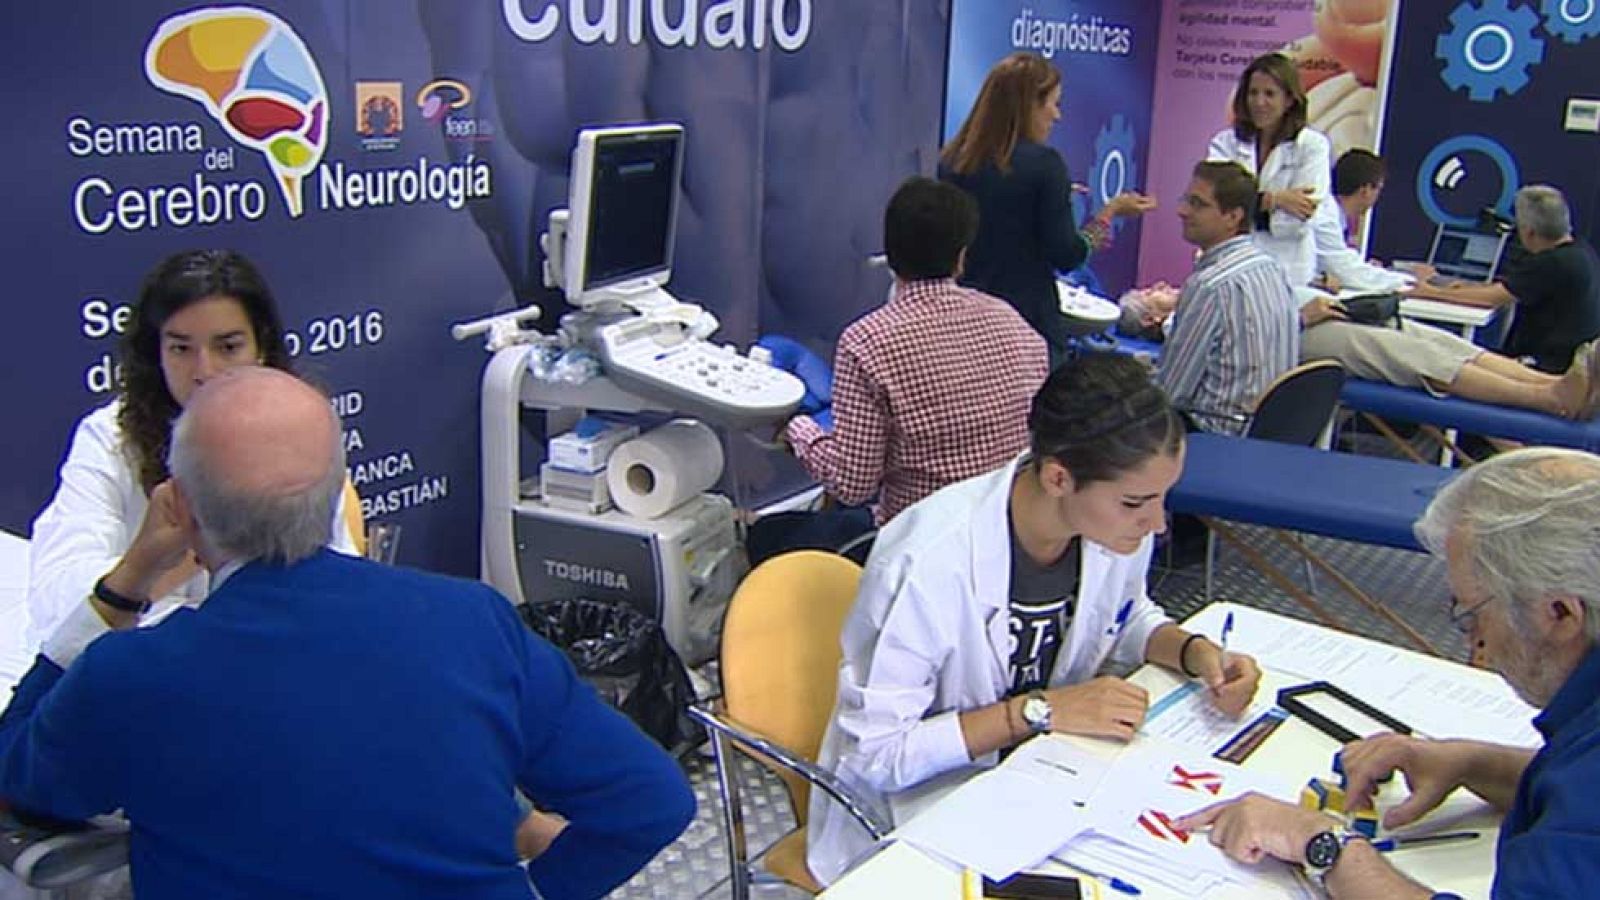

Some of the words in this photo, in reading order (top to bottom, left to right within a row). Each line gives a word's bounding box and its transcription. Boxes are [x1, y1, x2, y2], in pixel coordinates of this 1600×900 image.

[1013, 8, 1131, 58] diagnósticas
[1176, 49, 1217, 65] Tarjeta
[68, 118, 201, 155] Semana
[205, 147, 234, 170] del
[320, 155, 490, 209] Neurología
[74, 174, 266, 233] Cerebro
[309, 311, 383, 353] 2016
[361, 477, 448, 519] BASTIÁN
[544, 560, 629, 590] TOSHIBA
